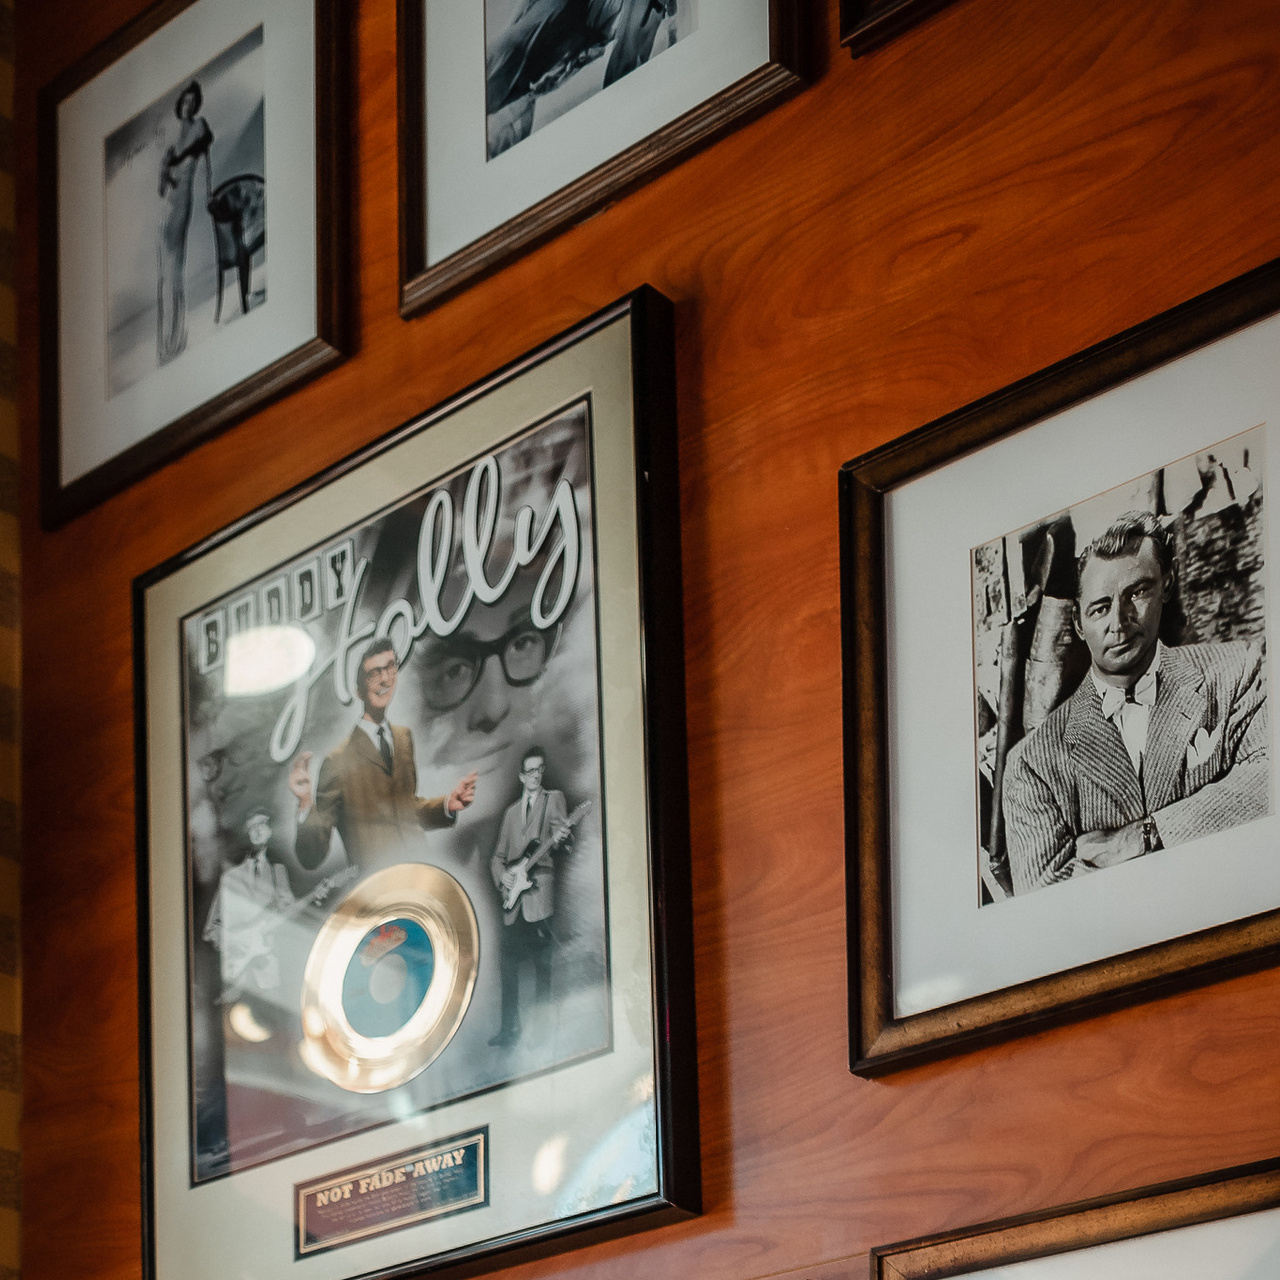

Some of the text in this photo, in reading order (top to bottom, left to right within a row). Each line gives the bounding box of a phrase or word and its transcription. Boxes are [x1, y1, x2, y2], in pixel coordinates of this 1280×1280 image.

[270, 454, 582, 763] Holly
[316, 1181, 354, 1207] NOT
[358, 1166, 407, 1195] FADE
[412, 1149, 466, 1178] AWAY
